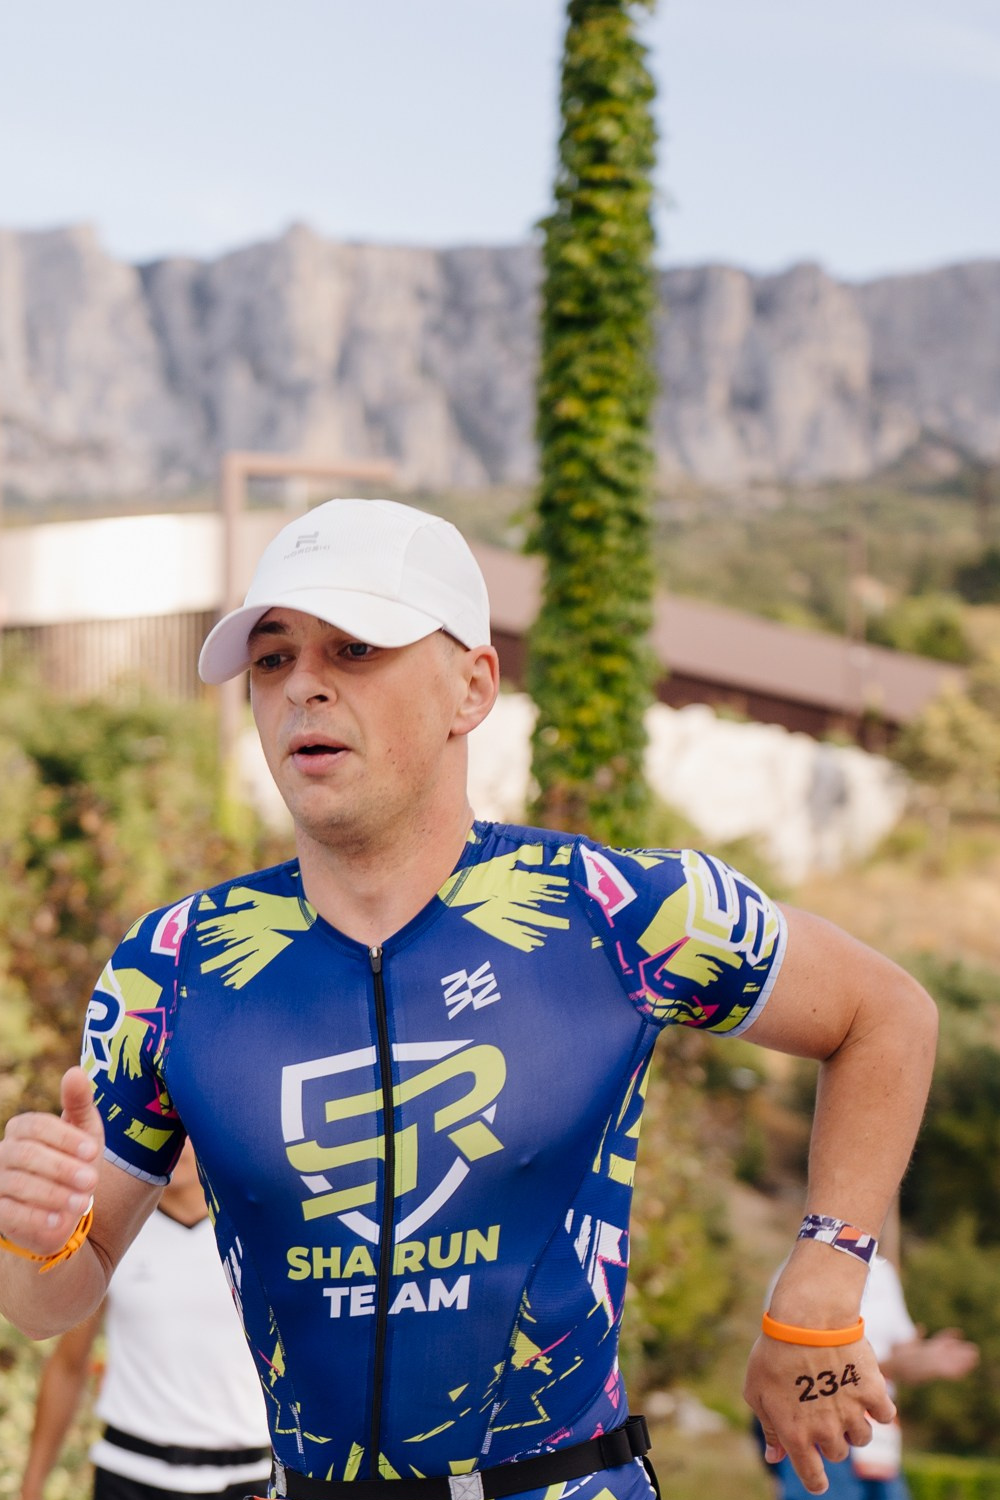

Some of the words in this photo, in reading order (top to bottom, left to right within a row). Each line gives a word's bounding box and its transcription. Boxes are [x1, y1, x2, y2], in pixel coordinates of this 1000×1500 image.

[286, 1224, 500, 1281] SHARUN
[322, 1274, 471, 1319] TEAM
[795, 1363, 862, 1403] 234
